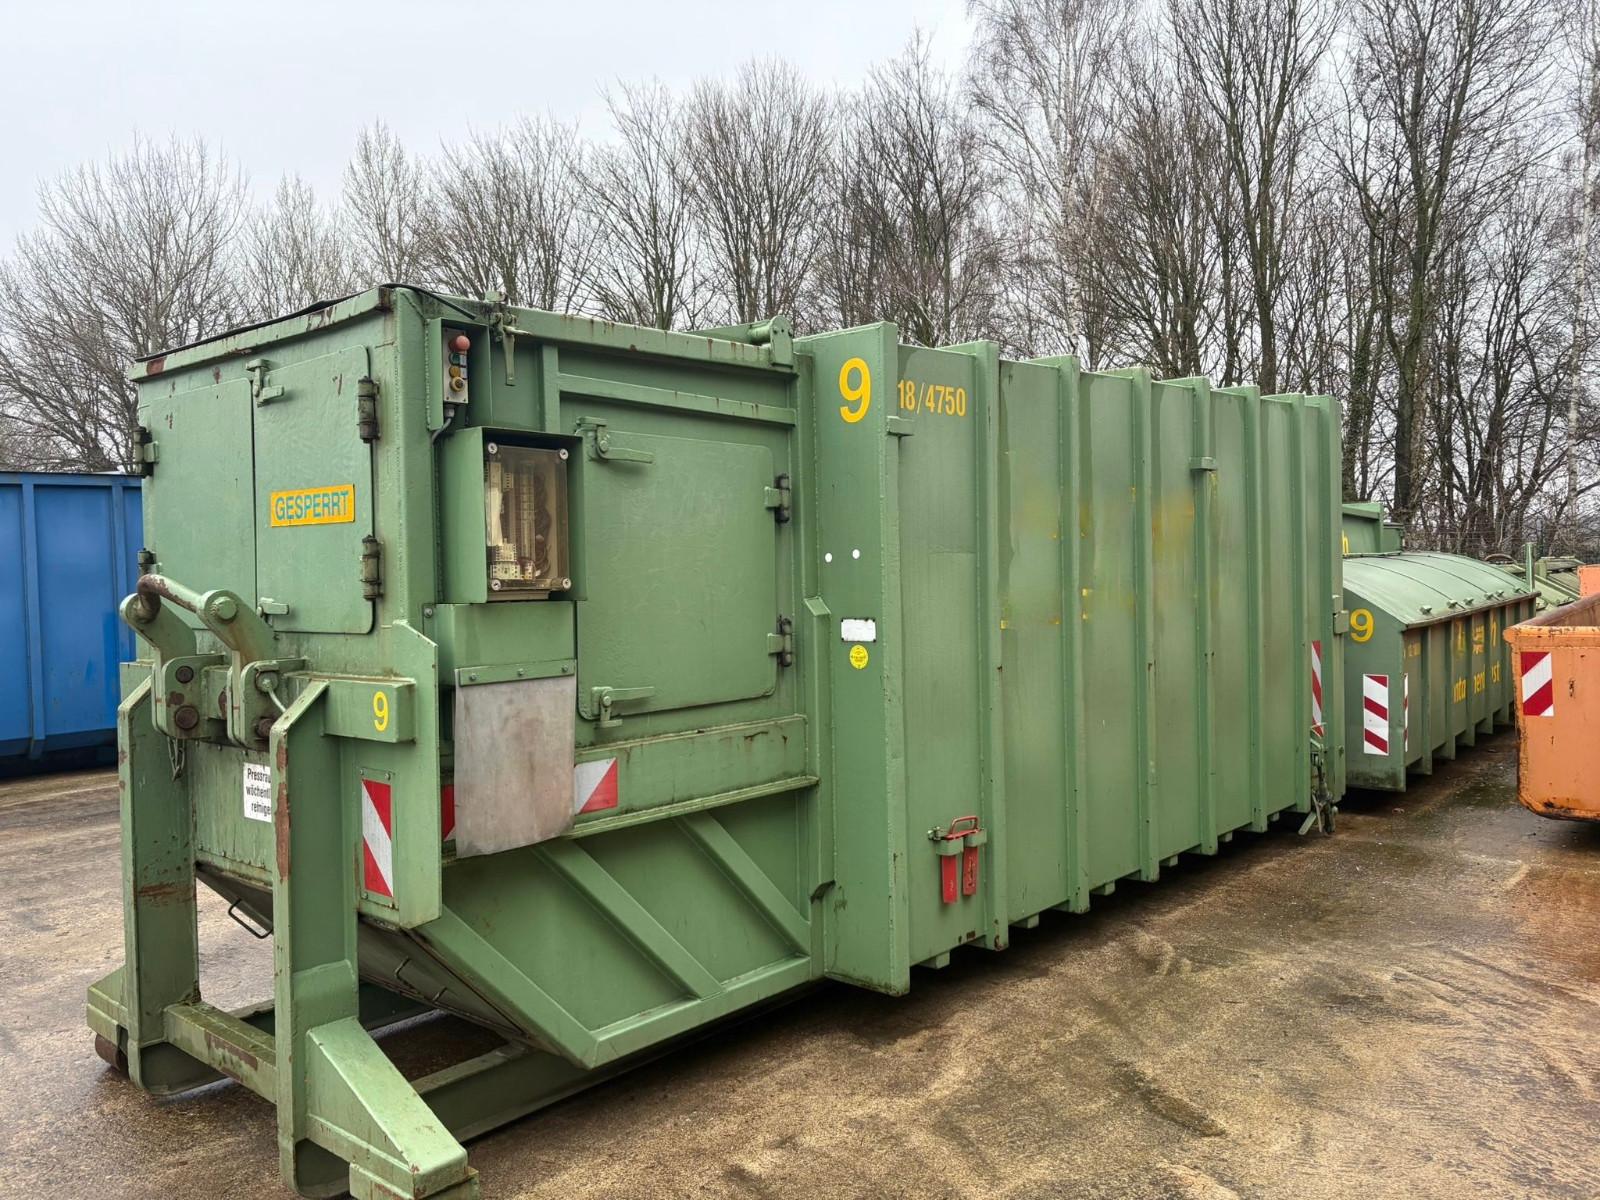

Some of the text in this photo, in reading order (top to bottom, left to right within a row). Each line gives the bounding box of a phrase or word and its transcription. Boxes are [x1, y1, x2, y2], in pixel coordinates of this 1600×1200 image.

[839, 357, 871, 423] 9
[898, 379, 966, 416] 18/4750
[275, 490, 349, 521] GESPERRT
[1350, 608, 1374, 642] 9
[373, 691, 389, 731] 9
